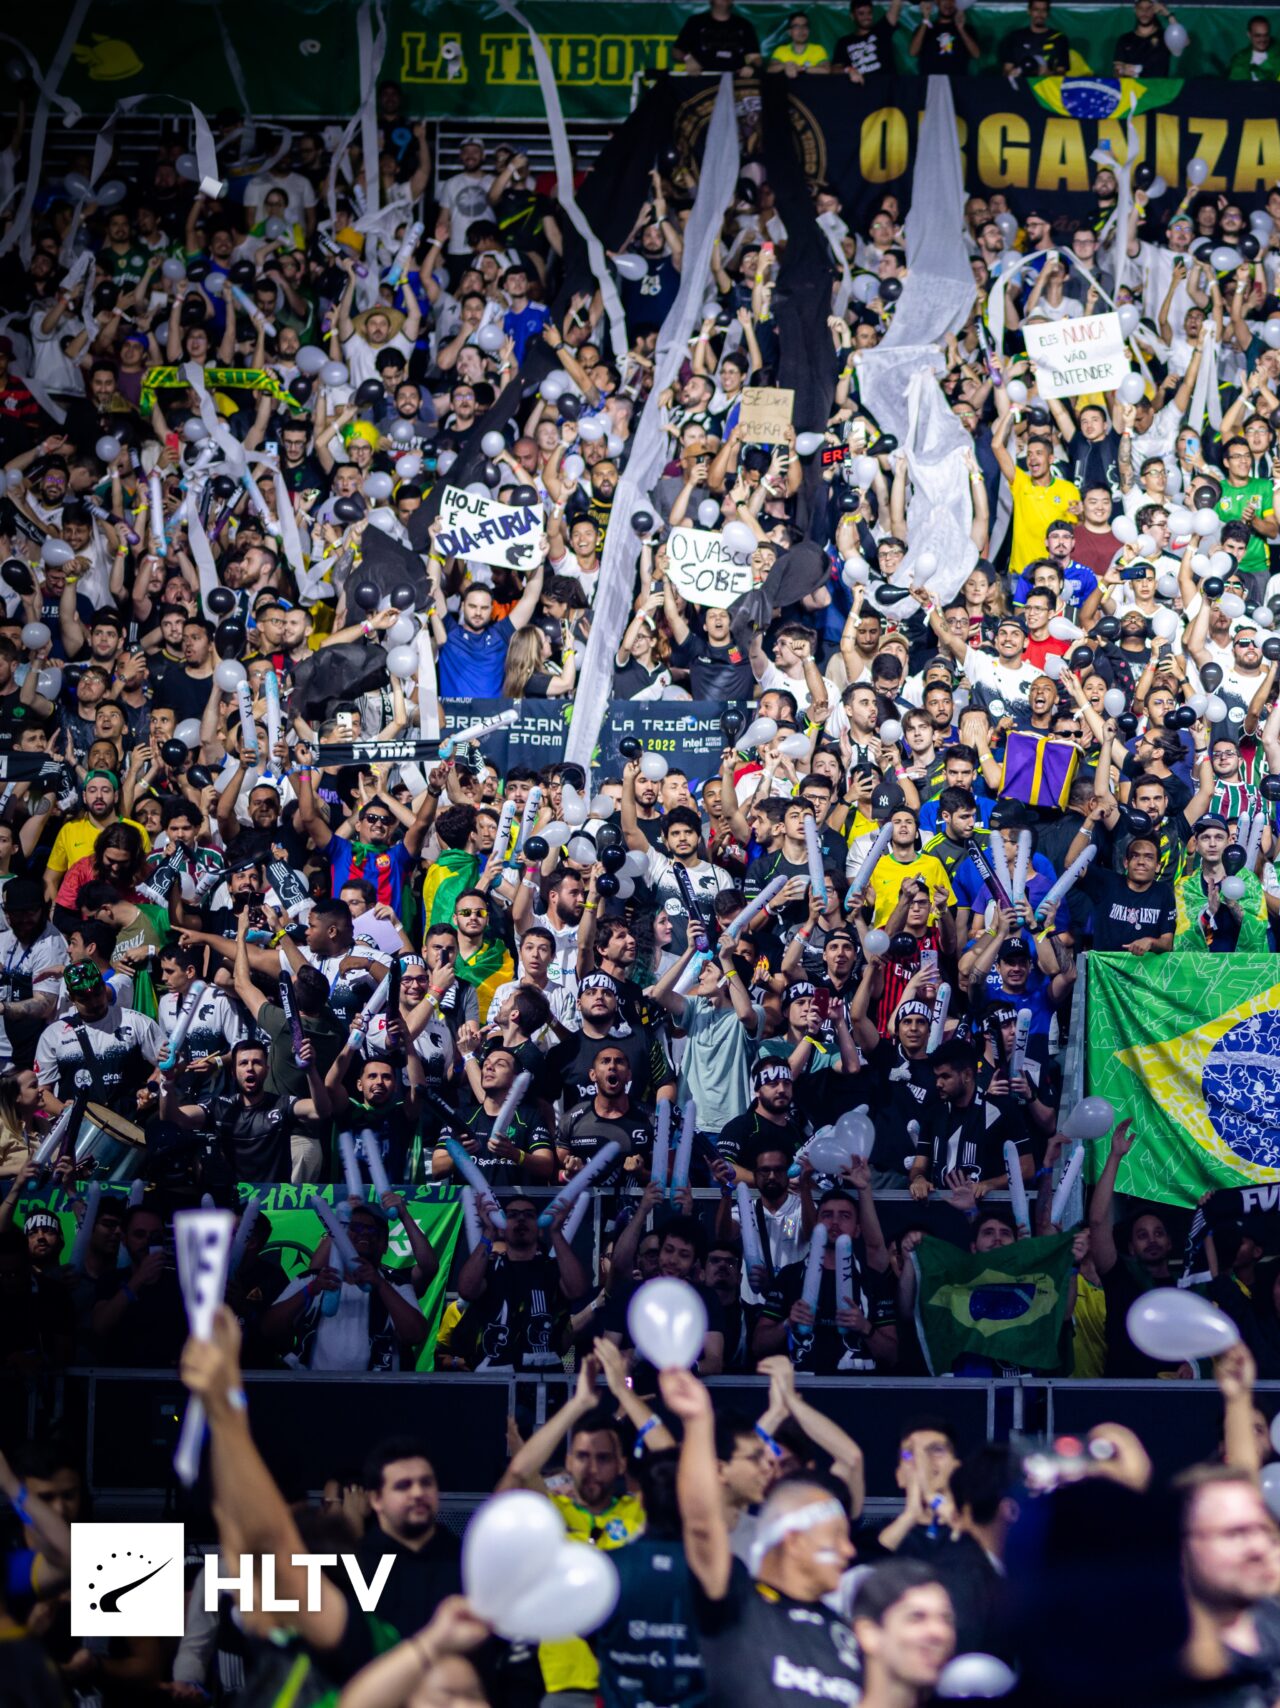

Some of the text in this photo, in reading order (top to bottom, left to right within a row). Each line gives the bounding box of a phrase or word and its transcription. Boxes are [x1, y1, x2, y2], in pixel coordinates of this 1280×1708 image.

[1062, 322, 1106, 345] NUNCA
[1052, 363, 1113, 387] ENTENDER
[445, 489, 490, 518] HOJE
[448, 510, 459, 526] É
[436, 526, 481, 558] DIA
[479, 504, 542, 545] FURIA
[672, 533, 688, 561] O
[680, 563, 747, 594] SOBE
[445, 715, 562, 732] BRALIAN
[612, 720, 635, 731] LA
[509, 733, 562, 746] STORM
[647, 738, 677, 751] 2022
[682, 737, 703, 748] intel
